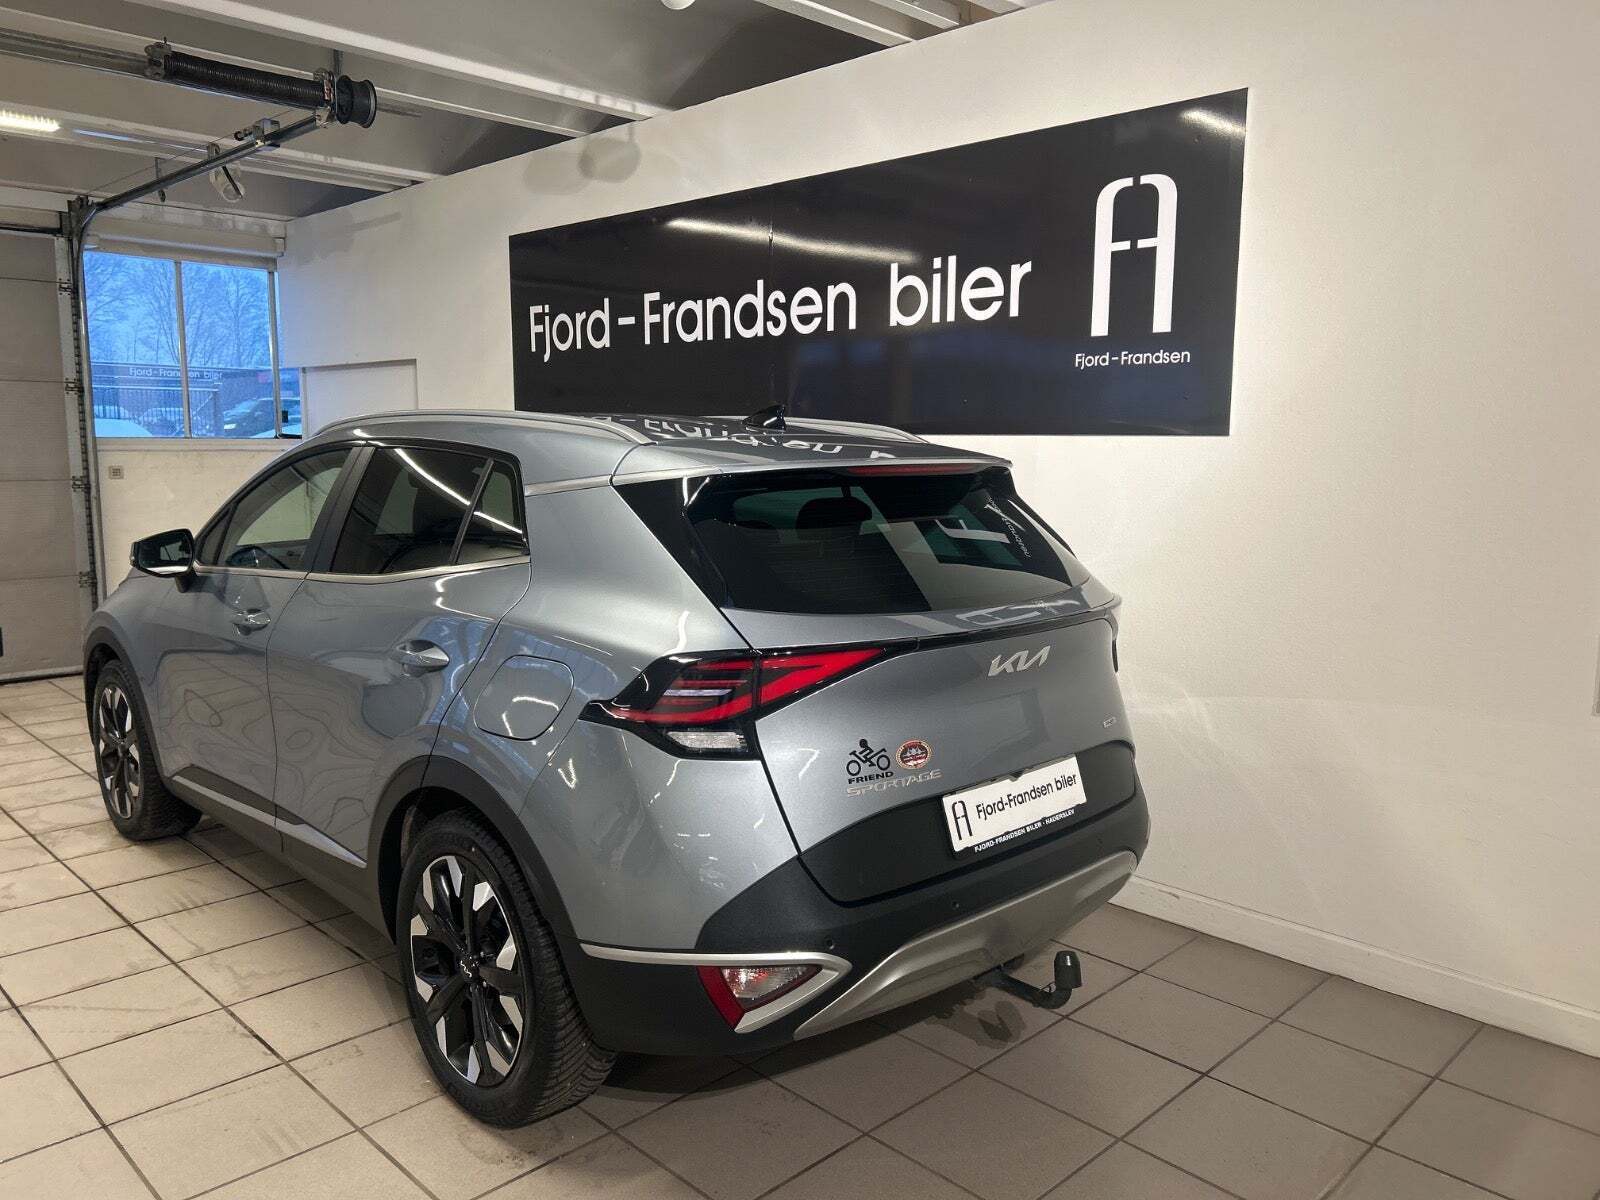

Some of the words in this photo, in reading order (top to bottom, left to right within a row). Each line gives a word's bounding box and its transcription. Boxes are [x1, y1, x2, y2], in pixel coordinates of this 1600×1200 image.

[889, 255, 1032, 327] biler
[846, 769, 943, 797] SPORTAGE
[847, 771, 894, 785] FRIEND
[975, 782, 1054, 821] Fjord-Frandsen
[1054, 774, 1078, 791] biler
[974, 828, 1026, 853] FJORD-FRANDSEN
[1026, 822, 1043, 833] BILER
[1045, 808, 1076, 825] HADERSLEV
